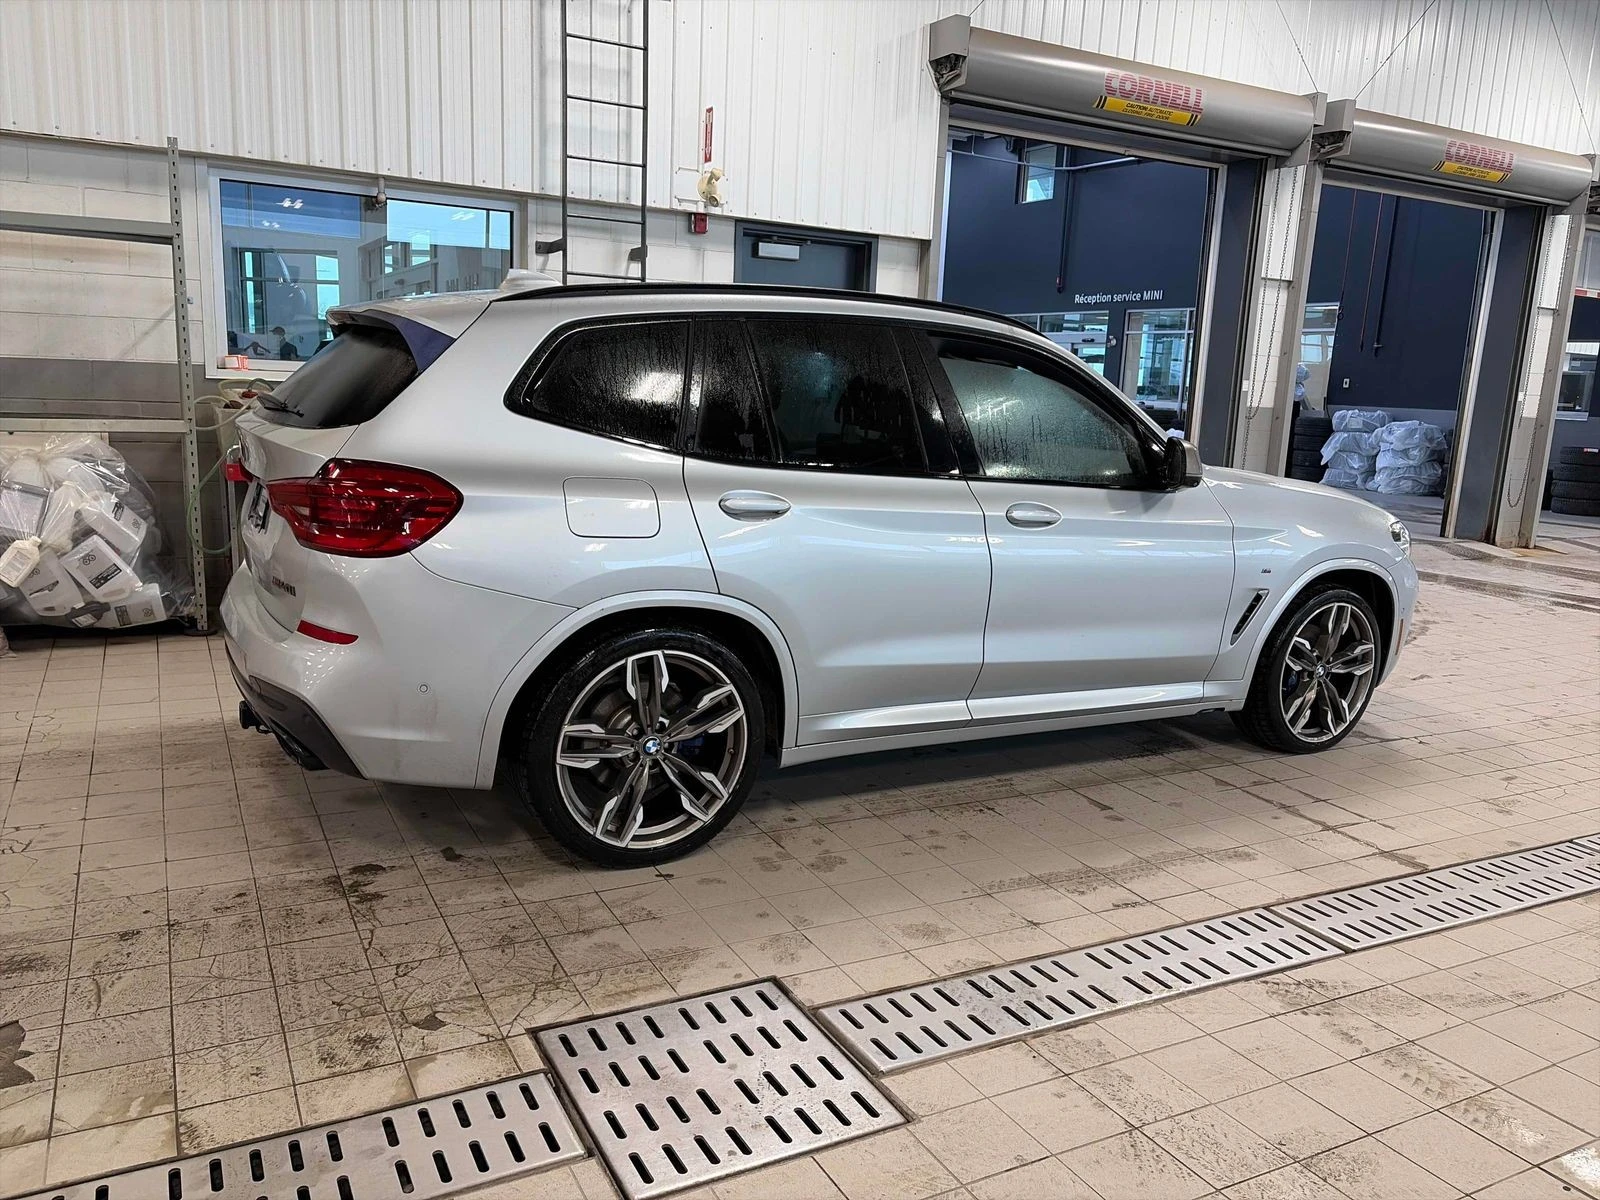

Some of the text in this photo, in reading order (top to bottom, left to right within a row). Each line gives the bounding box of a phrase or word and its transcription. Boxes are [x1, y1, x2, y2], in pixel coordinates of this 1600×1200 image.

[1104, 70, 1203, 114] CORNELL
[1445, 140, 1514, 174] CORNELL
[1074, 290, 1163, 305] Réception service MINI
